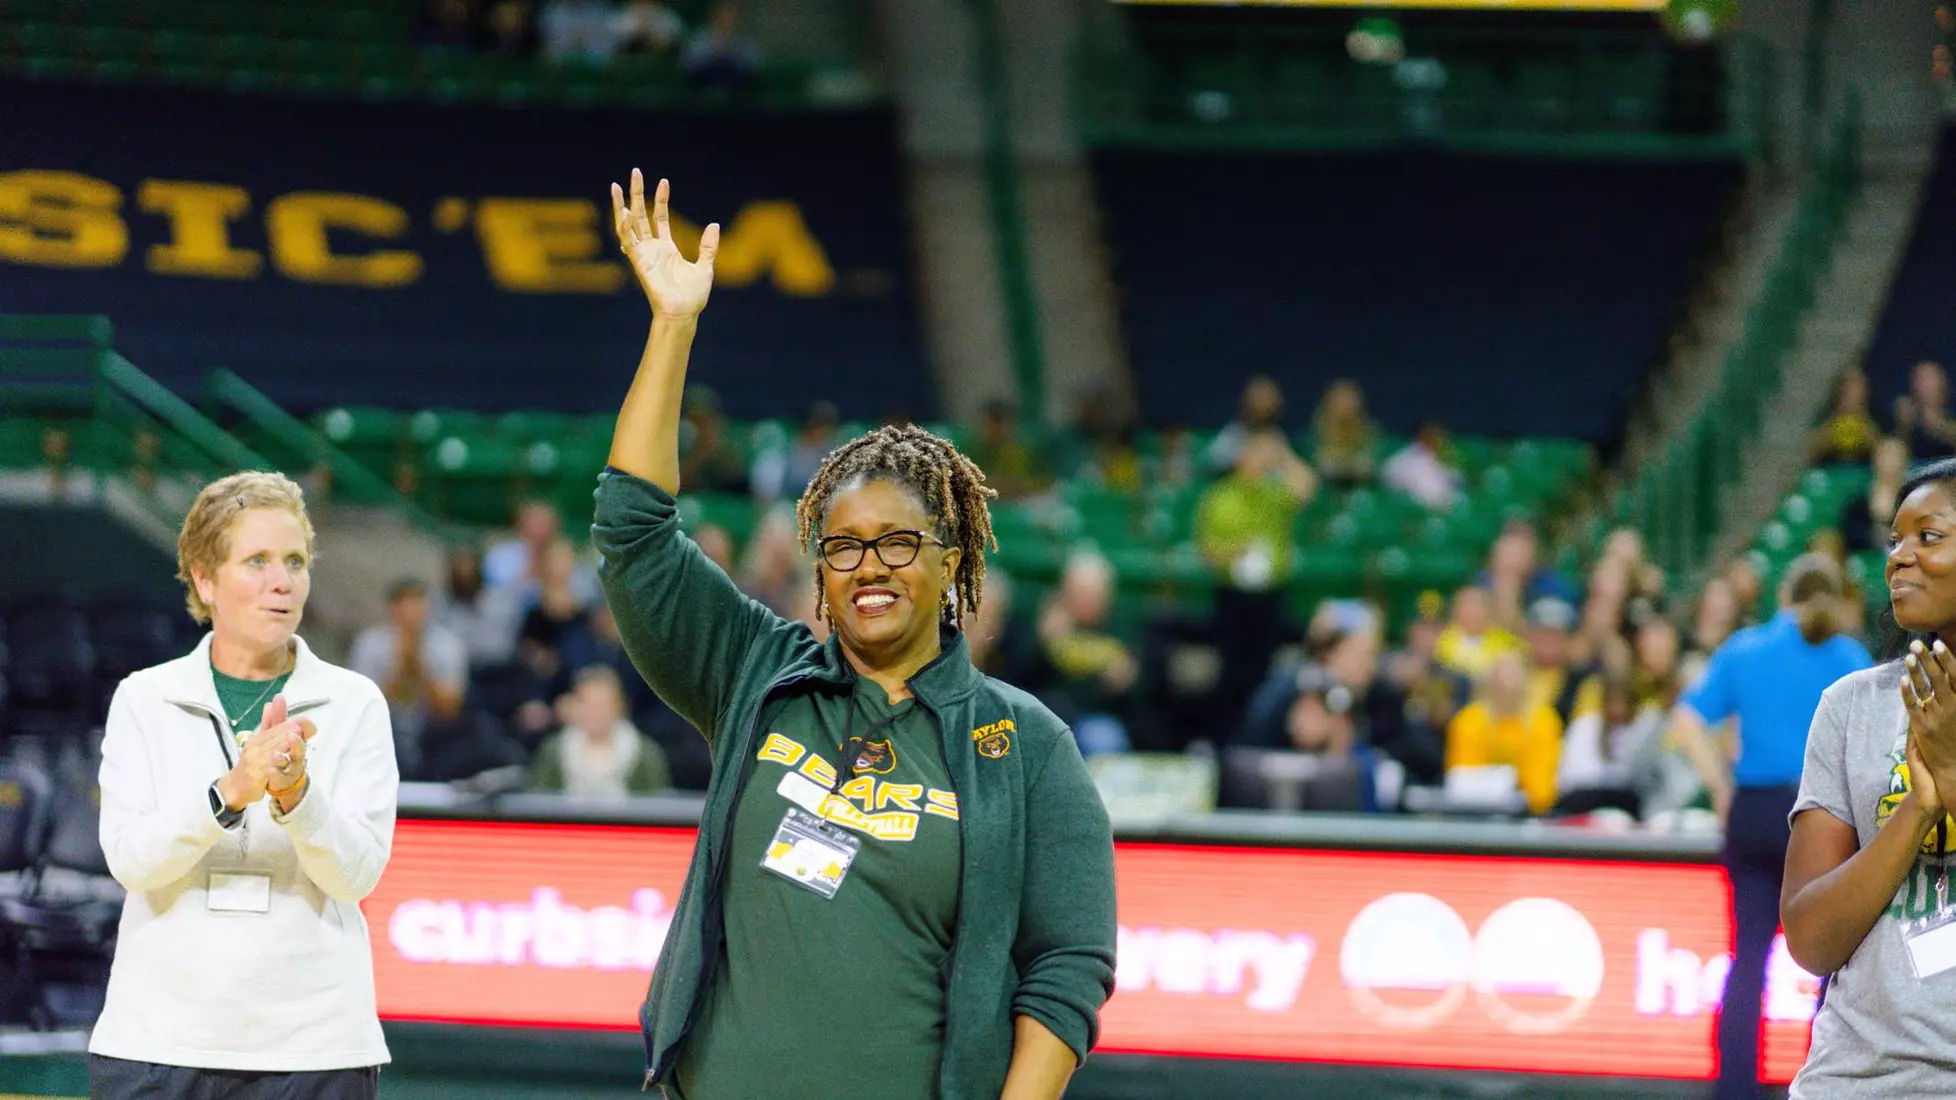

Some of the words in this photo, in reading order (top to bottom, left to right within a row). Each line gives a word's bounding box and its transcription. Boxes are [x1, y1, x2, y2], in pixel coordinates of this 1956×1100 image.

[0, 169, 422, 287] SIC
[757, 732, 959, 821] BEARS
[971, 719, 1016, 741] AYLOR
[388, 886, 677, 971] curbsi
[1115, 923, 1316, 1012] very
